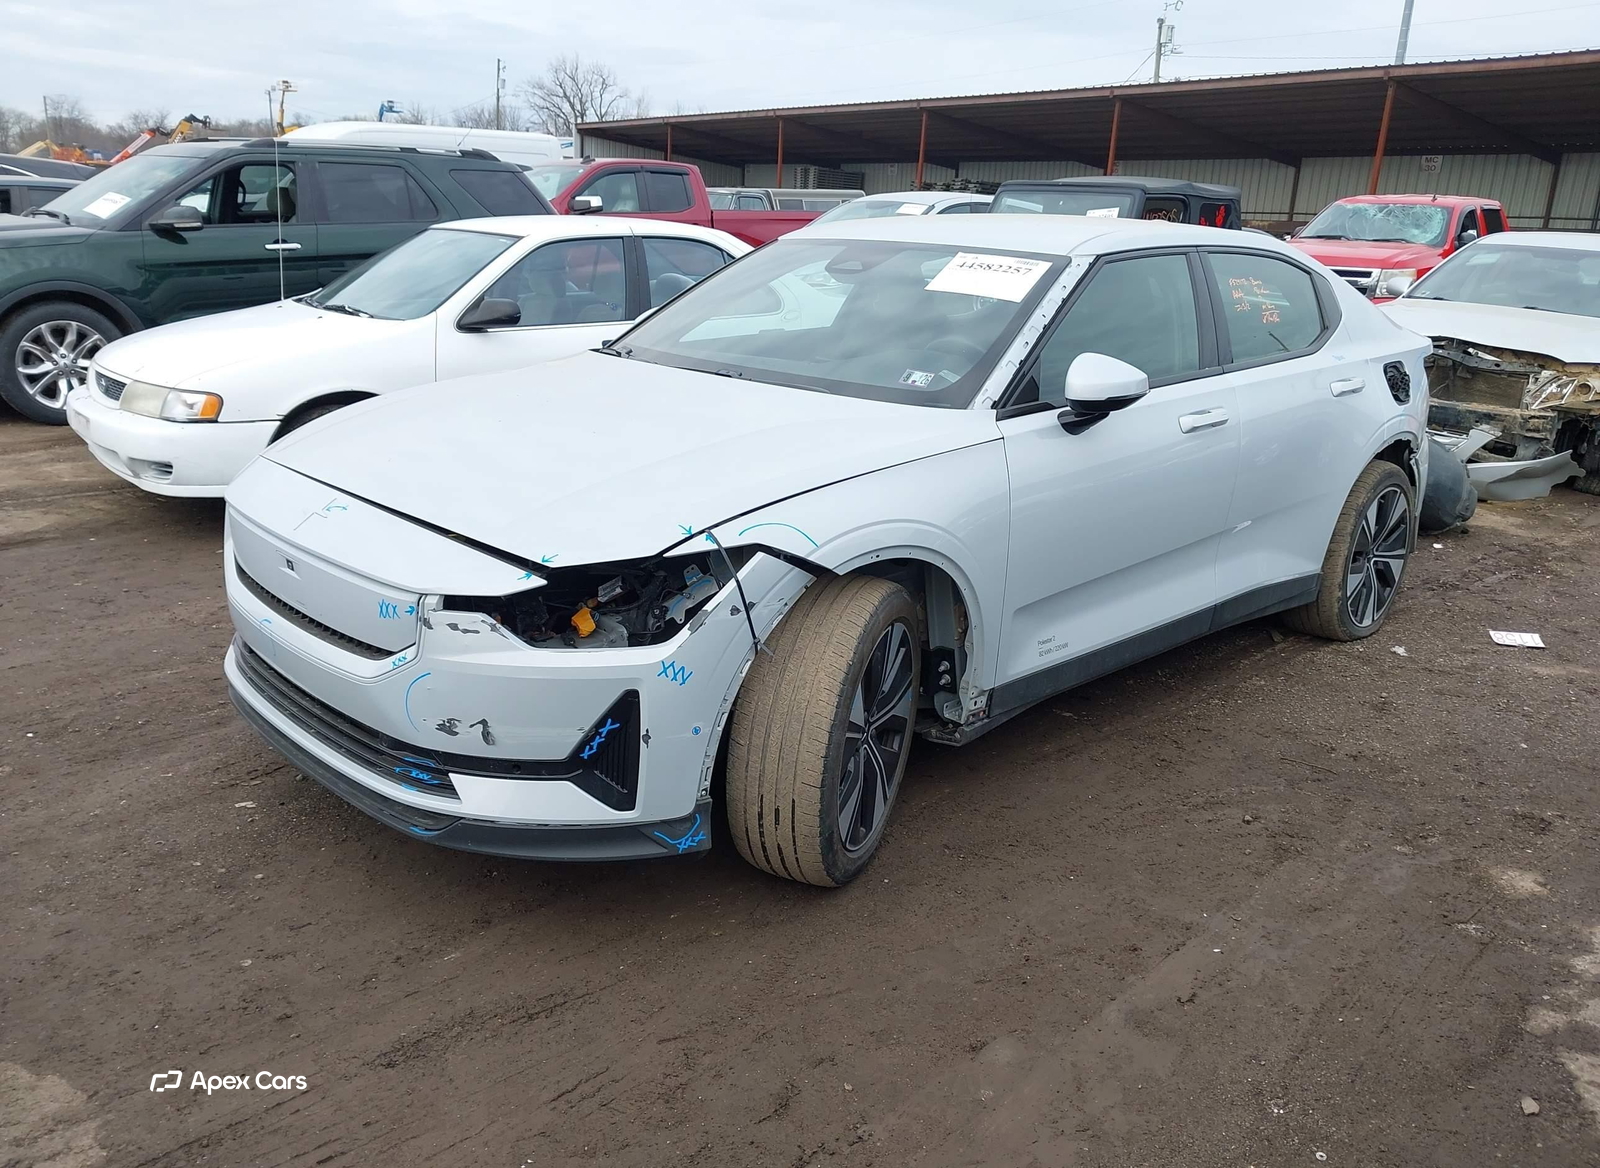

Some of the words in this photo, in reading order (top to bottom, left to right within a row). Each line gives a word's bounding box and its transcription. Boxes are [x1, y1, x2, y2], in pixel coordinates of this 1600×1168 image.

[1424, 156, 1439, 164] MC
[1424, 164, 1437, 172] 30
[956, 260, 1033, 277] 44582257
[1493, 632, 1541, 646] 1158
